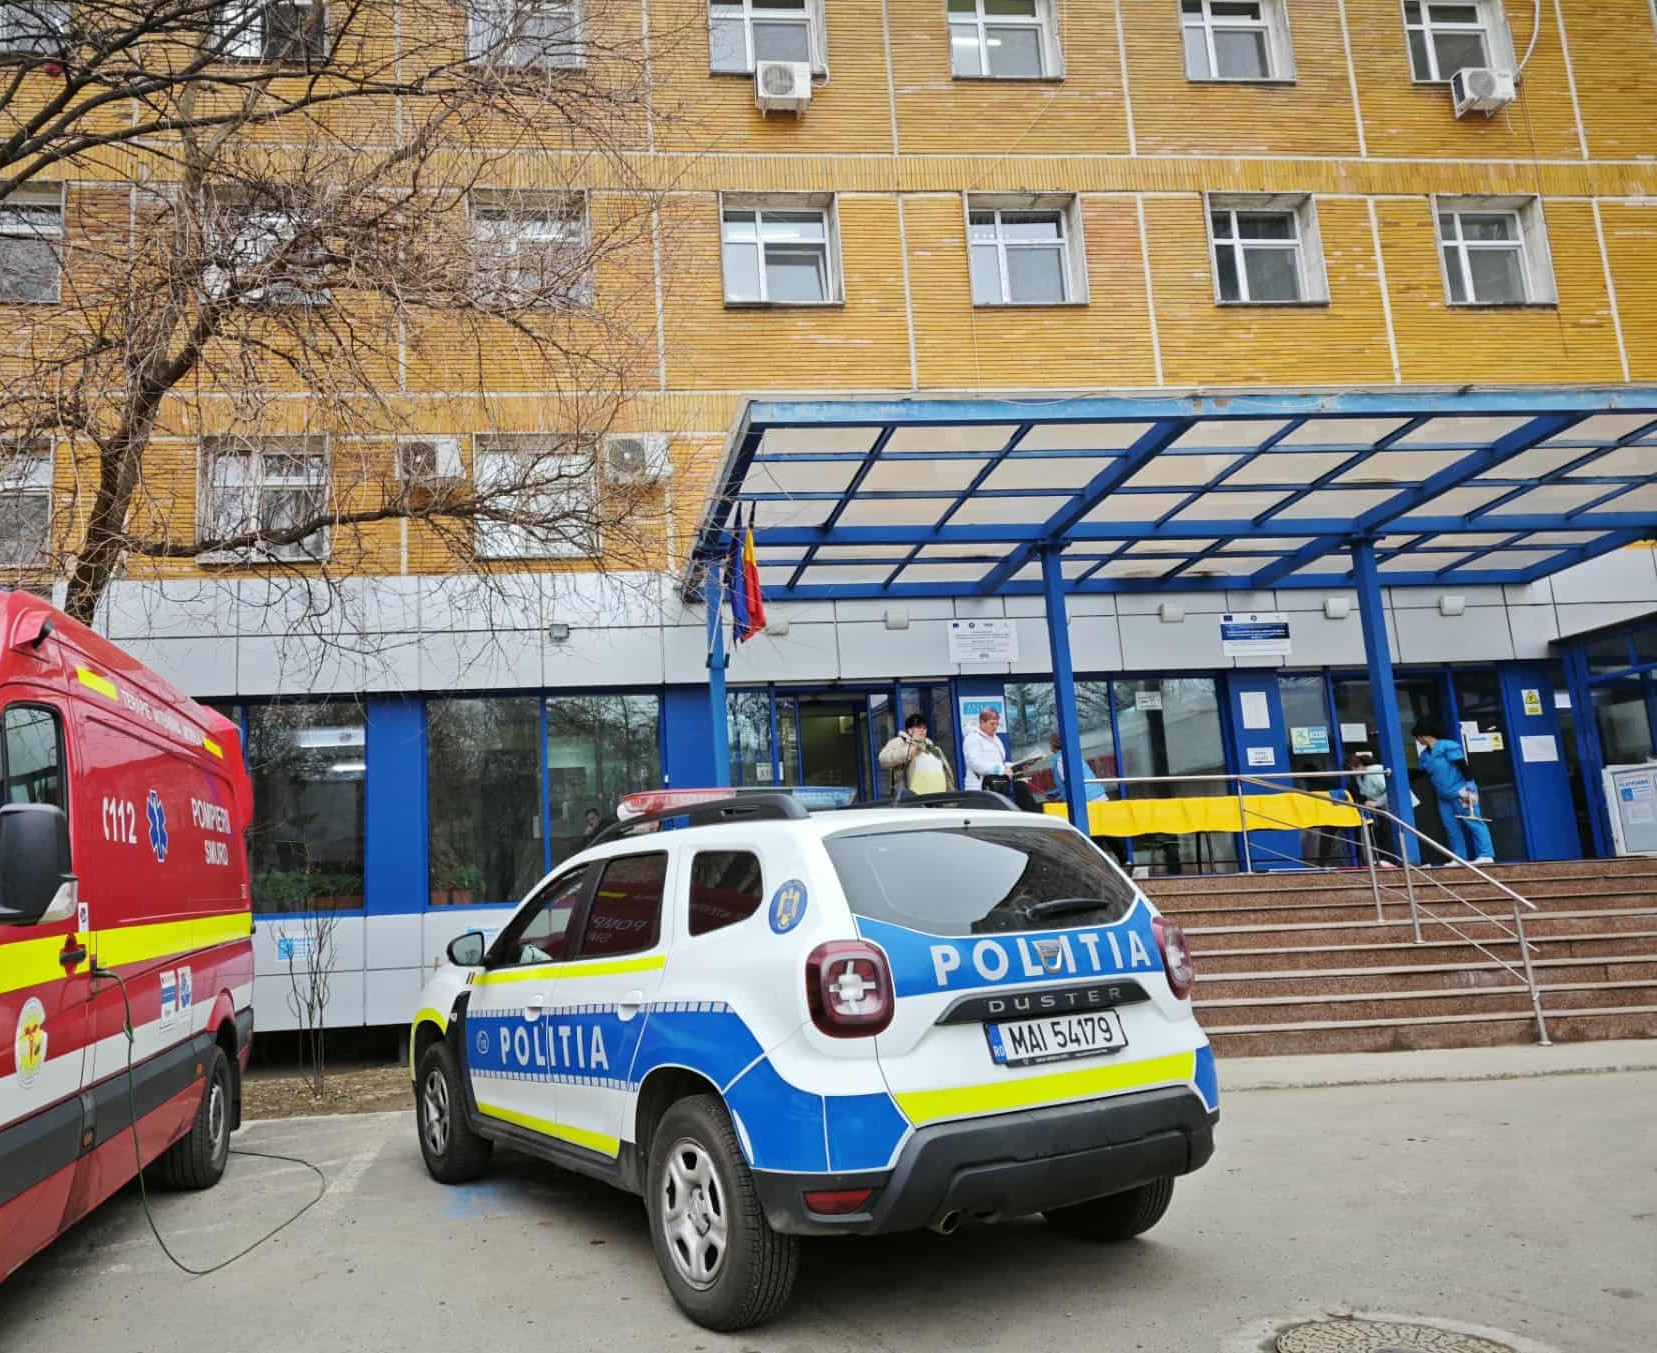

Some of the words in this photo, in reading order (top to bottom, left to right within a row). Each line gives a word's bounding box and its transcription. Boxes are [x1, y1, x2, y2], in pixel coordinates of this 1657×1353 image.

[930, 930, 1151, 987] POLITIA
[988, 986, 1123, 1014] DUSTER
[499, 1023, 610, 1072] POLITIA
[1008, 1022, 1049, 1056] MAI
[1051, 1016, 1115, 1049] 54179
